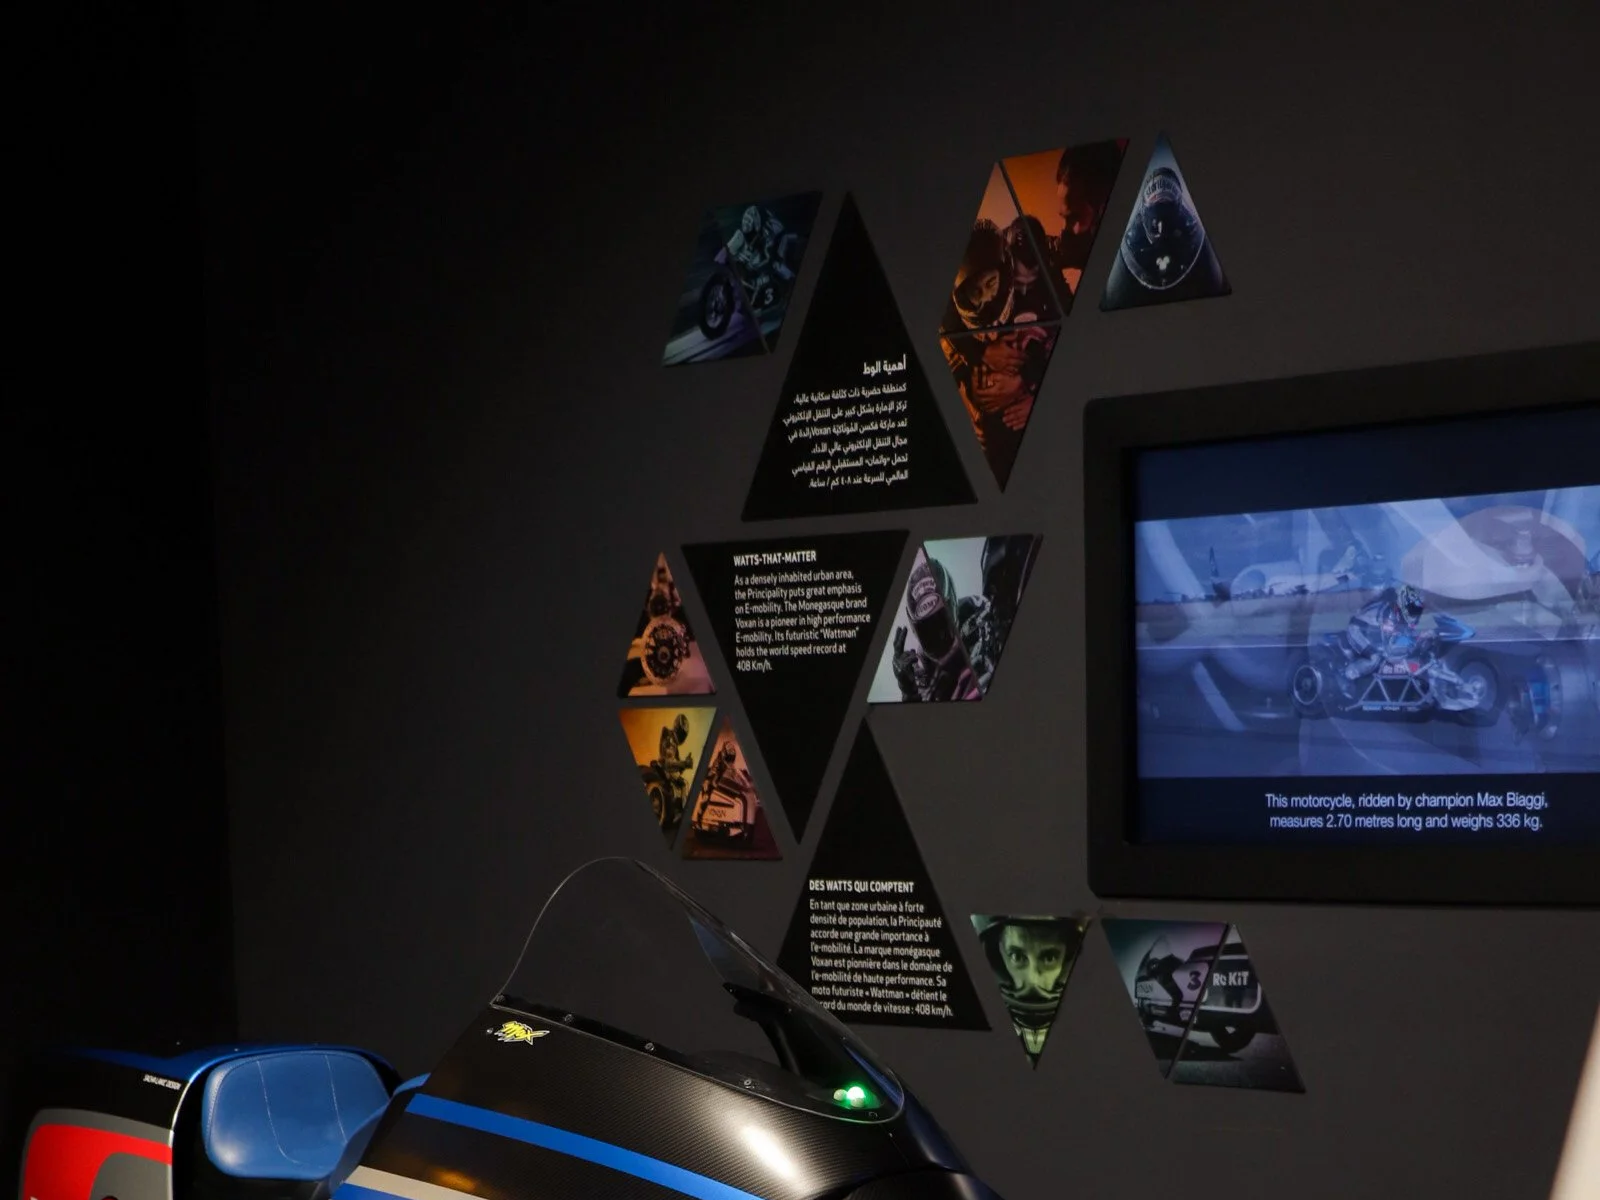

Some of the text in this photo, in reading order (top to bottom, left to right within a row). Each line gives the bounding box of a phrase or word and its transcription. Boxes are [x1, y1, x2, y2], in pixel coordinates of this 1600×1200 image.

[734, 550, 816, 566] WATTS-THAT-MATTER
[735, 570, 853, 586] As a densely inhabited urban area,
[735, 584, 862, 601] the Principality puts great emphasis
[735, 598, 867, 614] on E-mobility. The Monegasque brand
[735, 614, 870, 629] Voxan is a pioneer in high performance
[736, 632, 773, 644] E-mobility.
[775, 631, 784, 641] Its
[786, 630, 819, 640] futuristic
[736, 643, 846, 657] holds the world speed record at
[737, 659, 772, 672] 408 Km/h.
[1265, 792, 1547, 810] This motorcycle, ridden by champion Max Biaggi,
[1270, 813, 1542, 831] measures 2.70 metres long and weighs 336 kg.
[809, 880, 914, 893] DES WATTS QUI COMPTENT
[810, 900, 924, 913] En tant que zone urbaine à forte
[810, 914, 941, 929] densité de population, la Principauté
[811, 929, 929, 943] accorde une grande importance à
[854, 944, 863, 954] La
[864, 946, 892, 957] marque
[893, 946, 940, 959] monégasque
[811, 957, 952, 972] Voxan est pionnière dans le domaine de
[853, 973, 862, 983] de
[863, 973, 884, 984] haute
[885, 974, 934, 986] performance.
[936, 976, 946, 987] Sa
[811, 986, 947, 1001] moto futuriste Wattman détient le
[837, 1000, 846, 1010] du
[847, 1001, 871, 1012] monde
[873, 1002, 882, 1012] de
[883, 1003, 910, 1014] vitesse
[915, 1004, 930, 1015] 408
